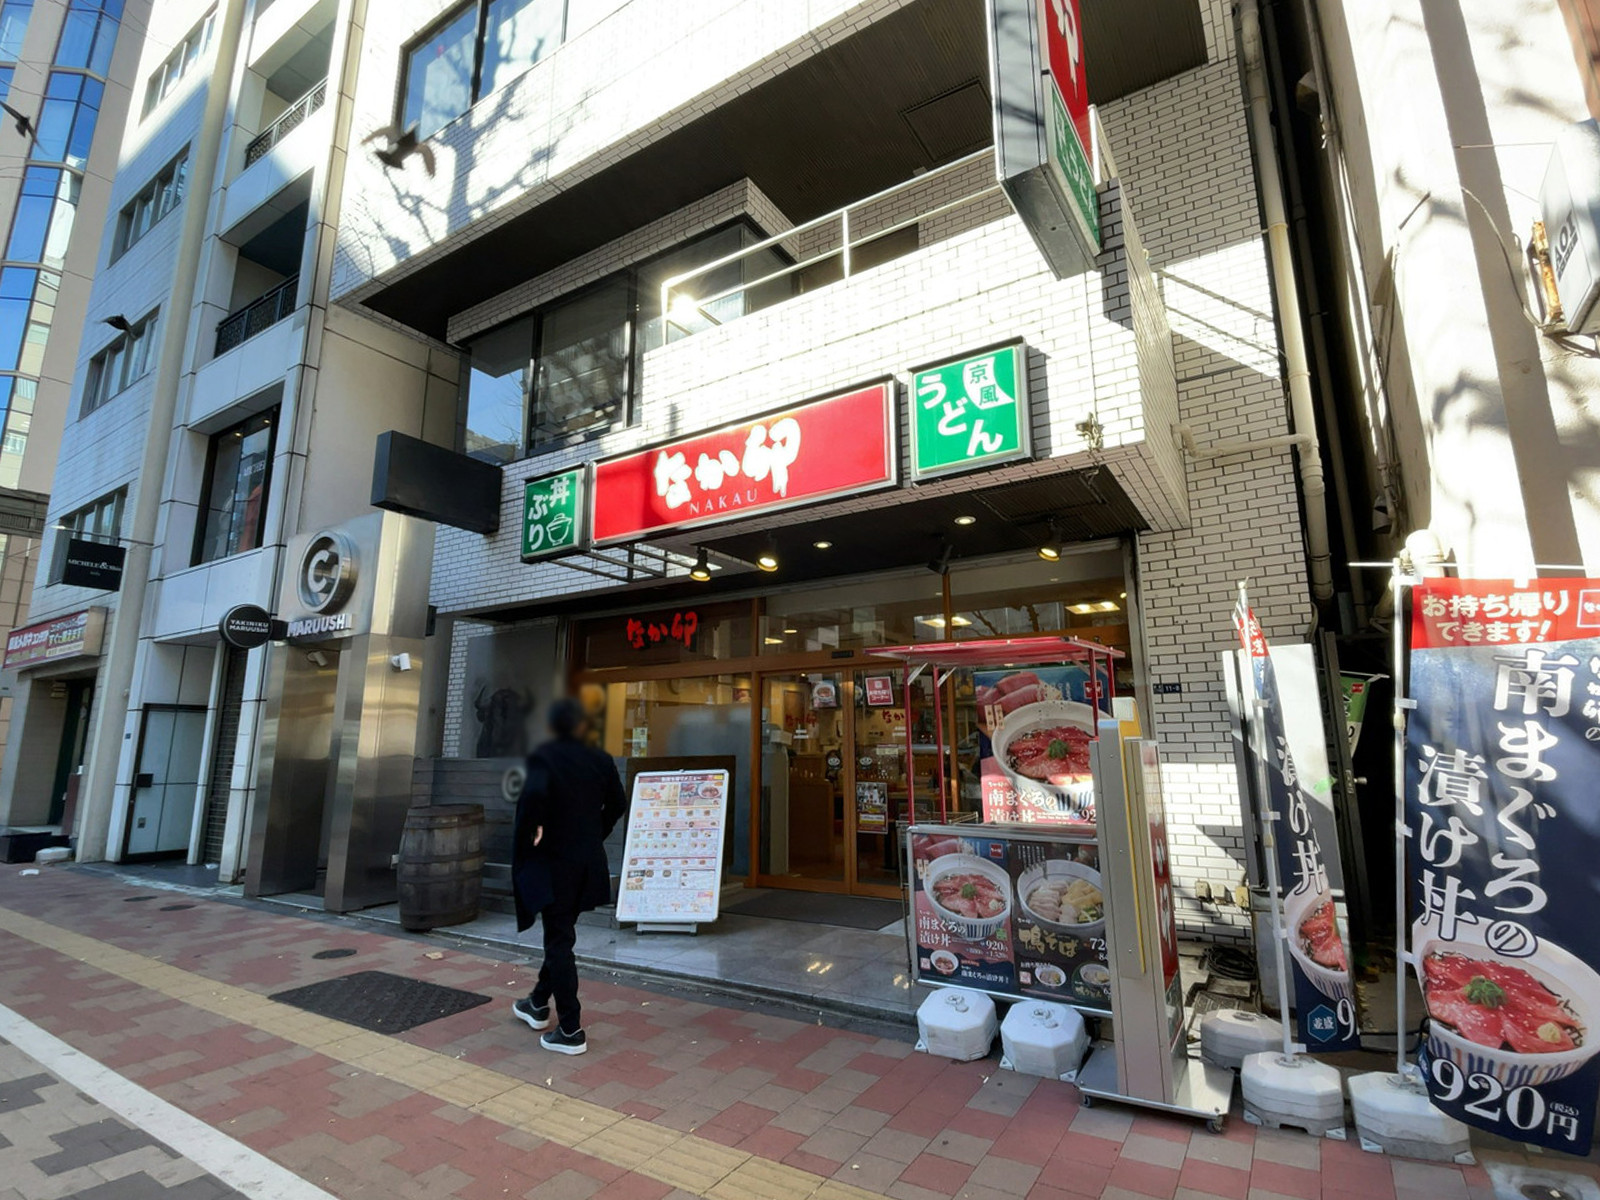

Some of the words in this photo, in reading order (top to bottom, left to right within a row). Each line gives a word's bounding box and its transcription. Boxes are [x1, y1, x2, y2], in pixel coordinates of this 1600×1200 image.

[968, 363, 1000, 406] 京風
[917, 372, 1004, 457] うどん
[654, 417, 802, 510] なか卯
[527, 476, 570, 551] 丼ぶり
[689, 488, 759, 515] NAKAU
[1422, 590, 1570, 618] お持ち帰り
[230, 625, 268, 633] MARUUSHI
[287, 612, 354, 637] MARUUSHI
[626, 611, 698, 649] なか卯
[1436, 620, 1552, 642] できます!
[988, 788, 1056, 810] 南まぐろの
[1484, 649, 1580, 958] 南まぐろの
[1081, 808, 1098, 823] 92
[1417, 743, 1490, 941] 漬け丼
[919, 916, 967, 935] 南まぐろの
[919, 930, 951, 947] 漬け丼
[1089, 937, 1107, 952] 72
